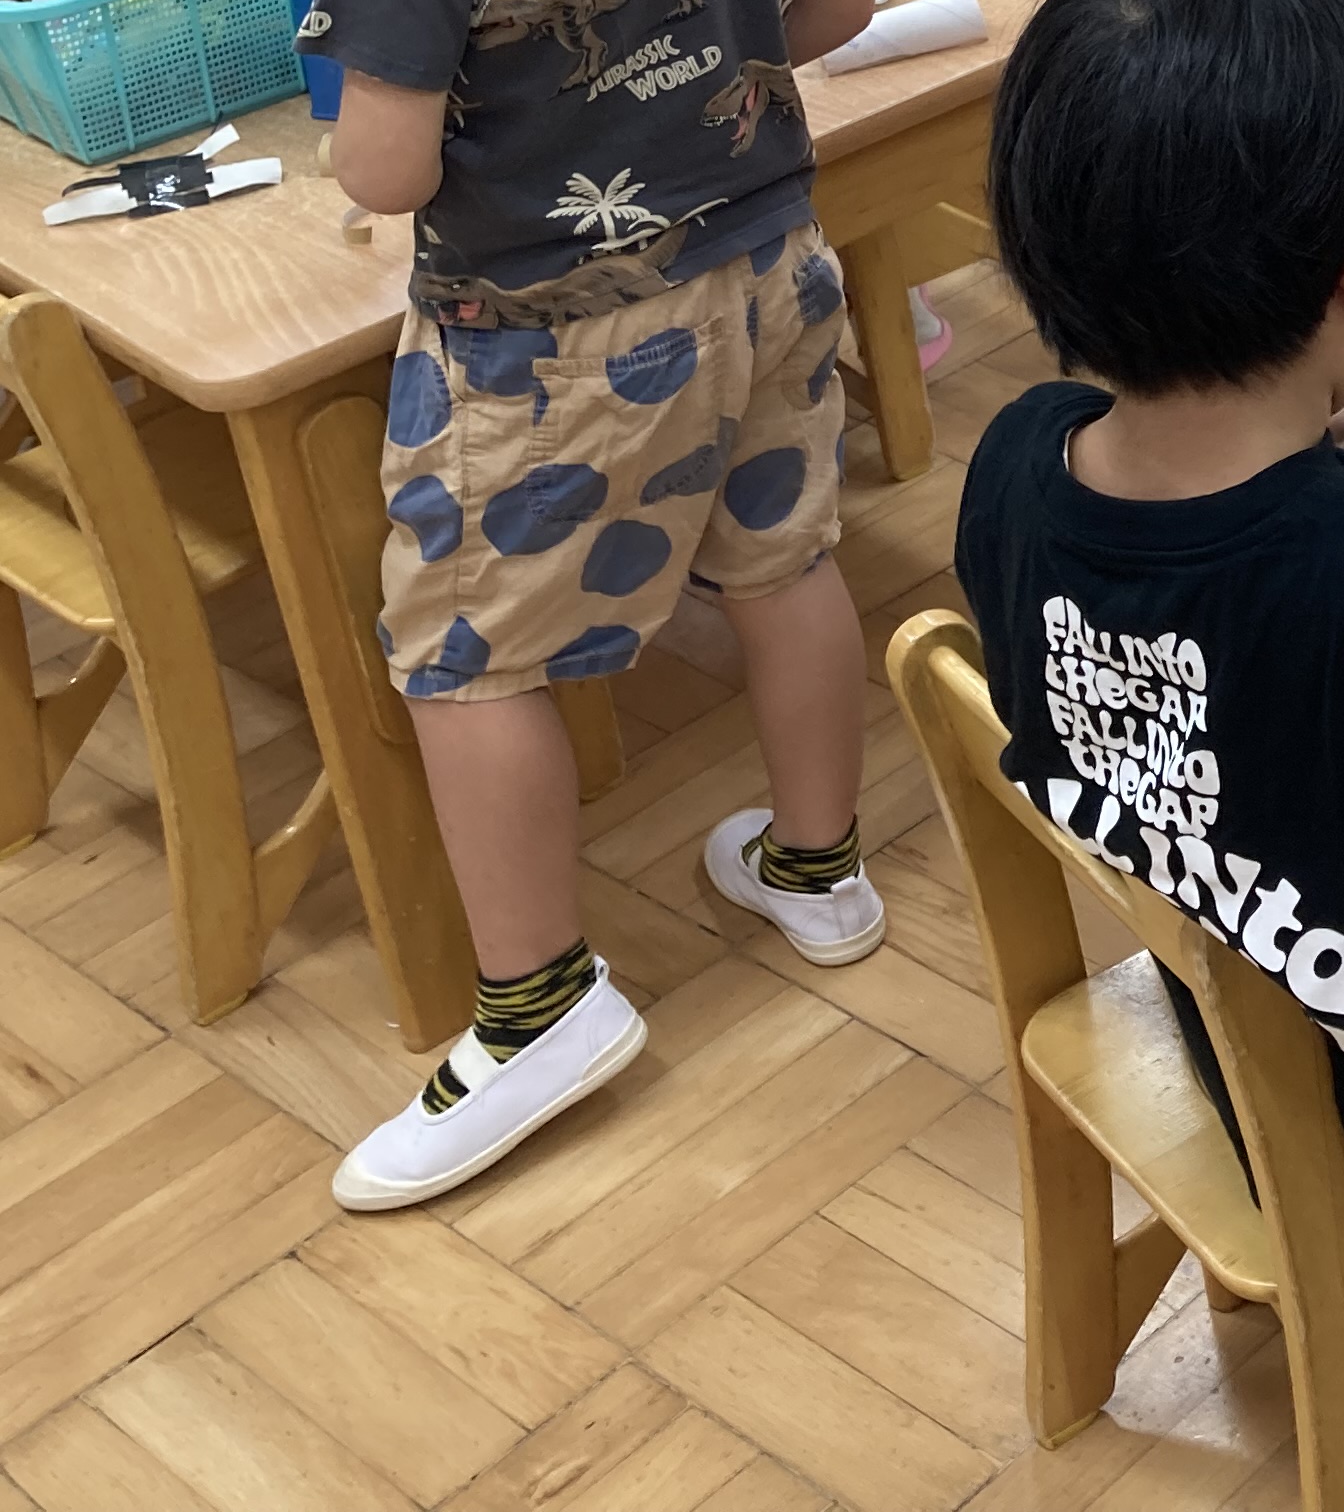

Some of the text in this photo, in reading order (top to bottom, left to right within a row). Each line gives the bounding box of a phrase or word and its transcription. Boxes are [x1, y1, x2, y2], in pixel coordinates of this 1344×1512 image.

[586, 34, 681, 102] JURASSIC
[624, 45, 722, 101] WORLD
[1043, 596, 1126, 671] FALL
[1046, 689, 1146, 759] FALL
[1135, 771, 1219, 839] GAP
